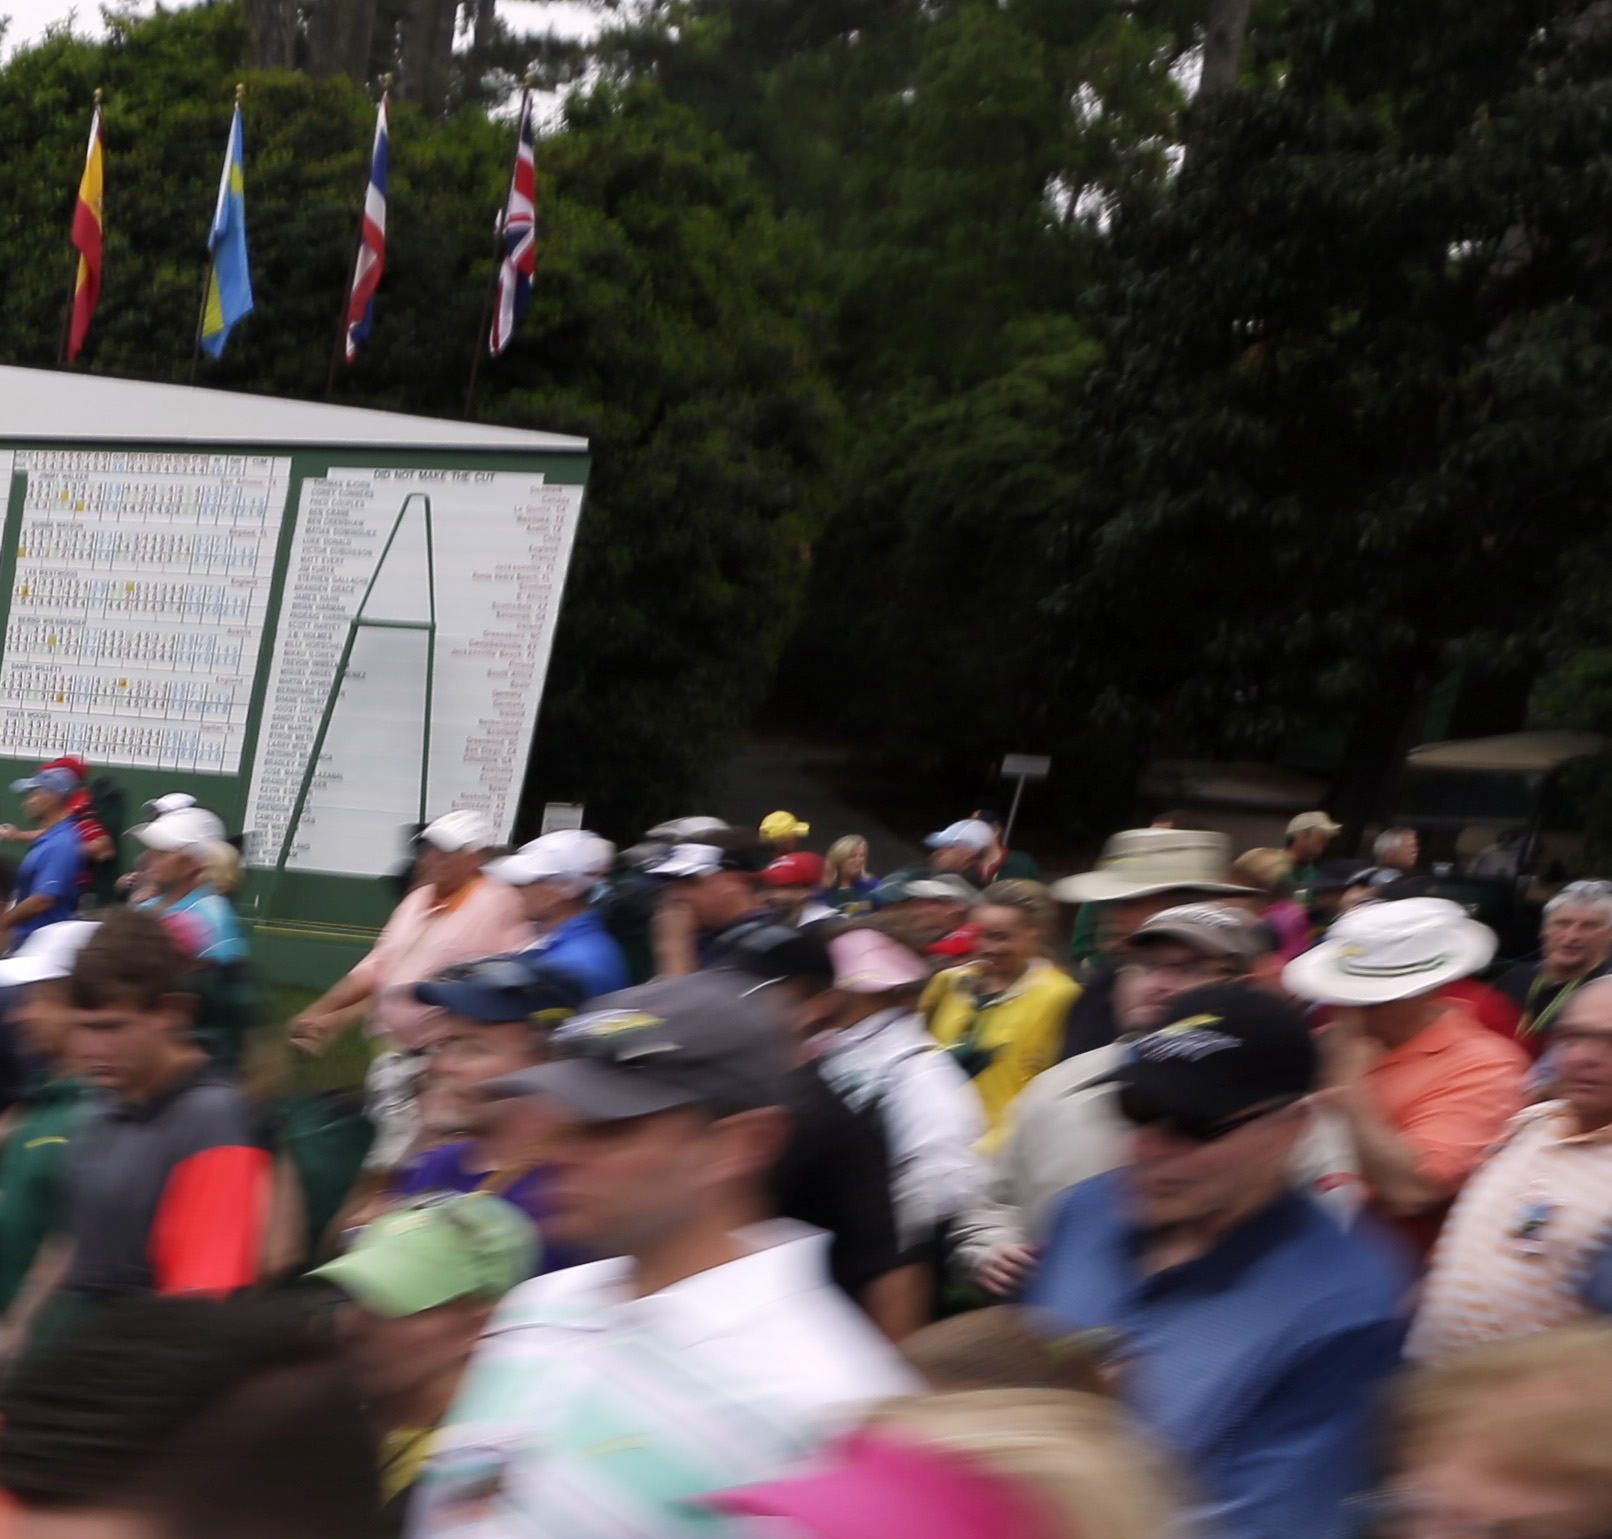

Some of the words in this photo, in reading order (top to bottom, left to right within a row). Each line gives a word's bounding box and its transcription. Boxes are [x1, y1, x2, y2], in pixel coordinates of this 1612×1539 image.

[374, 470, 394, 479] DID
[396, 471, 415, 480] NOT
[419, 471, 444, 480] MAKE
[452, 472, 471, 481] THE
[475, 473, 495, 482] CUT
